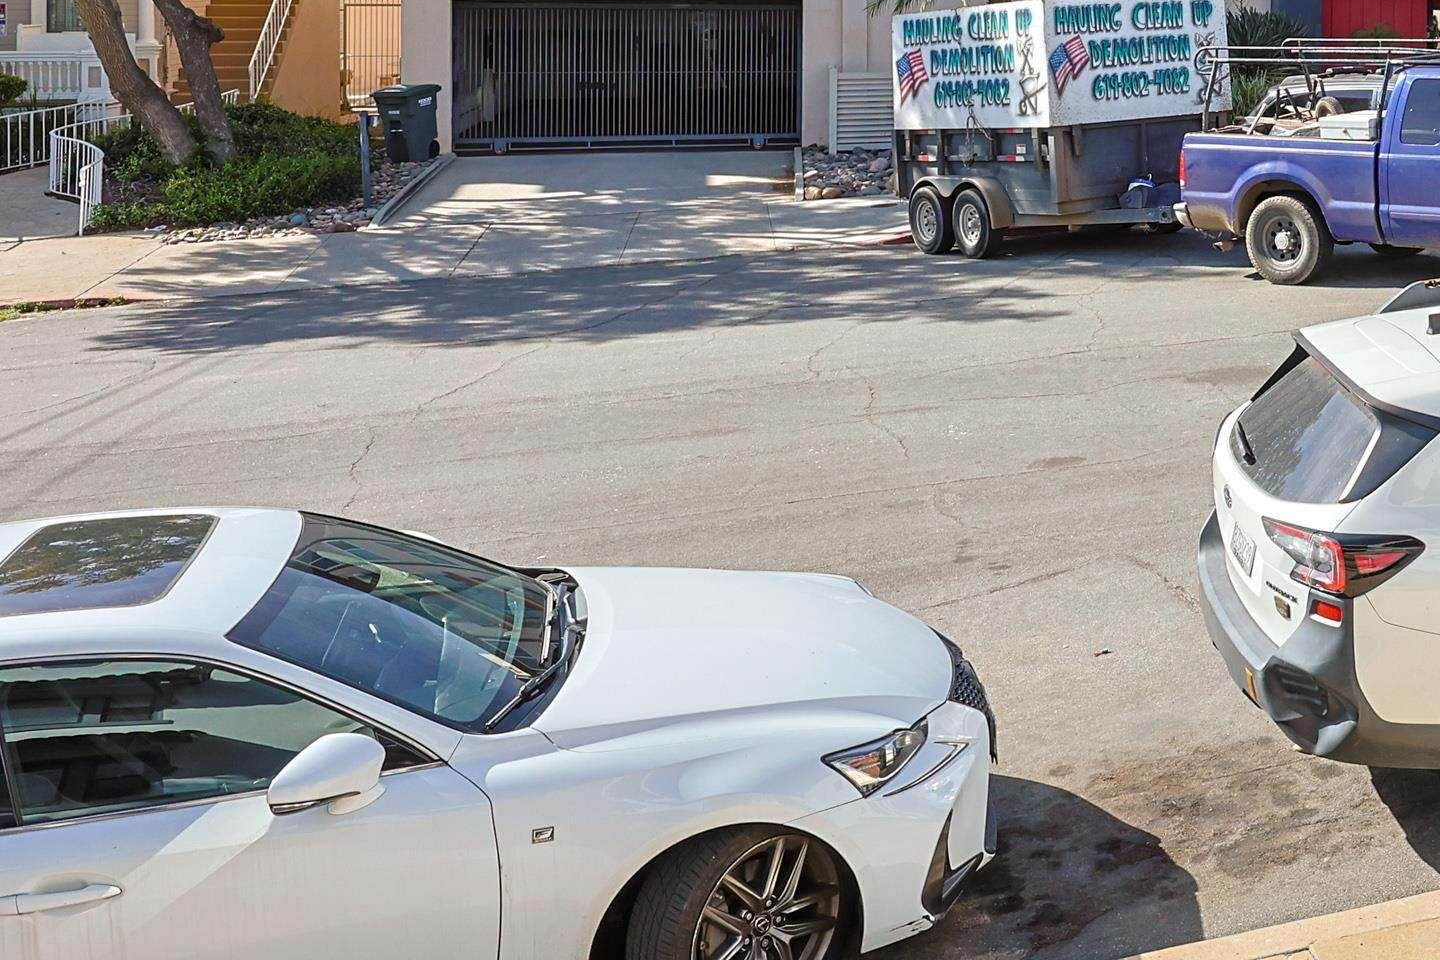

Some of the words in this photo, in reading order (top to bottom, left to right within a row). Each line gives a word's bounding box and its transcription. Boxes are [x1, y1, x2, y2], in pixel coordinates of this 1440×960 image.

[903, 14, 963, 47] HAULING
[967, 10, 1010, 41] CLEAN
[1015, 7, 1033, 38] UP
[1053, 2, 1123, 35] HAULING
[1131, 0, 1184, 31] CLEAN
[930, 43, 1015, 77] DEMOLITION
[1088, 33, 1191, 70] DEMOLITION
[1092, 66, 1191, 101] 619-802-4082
